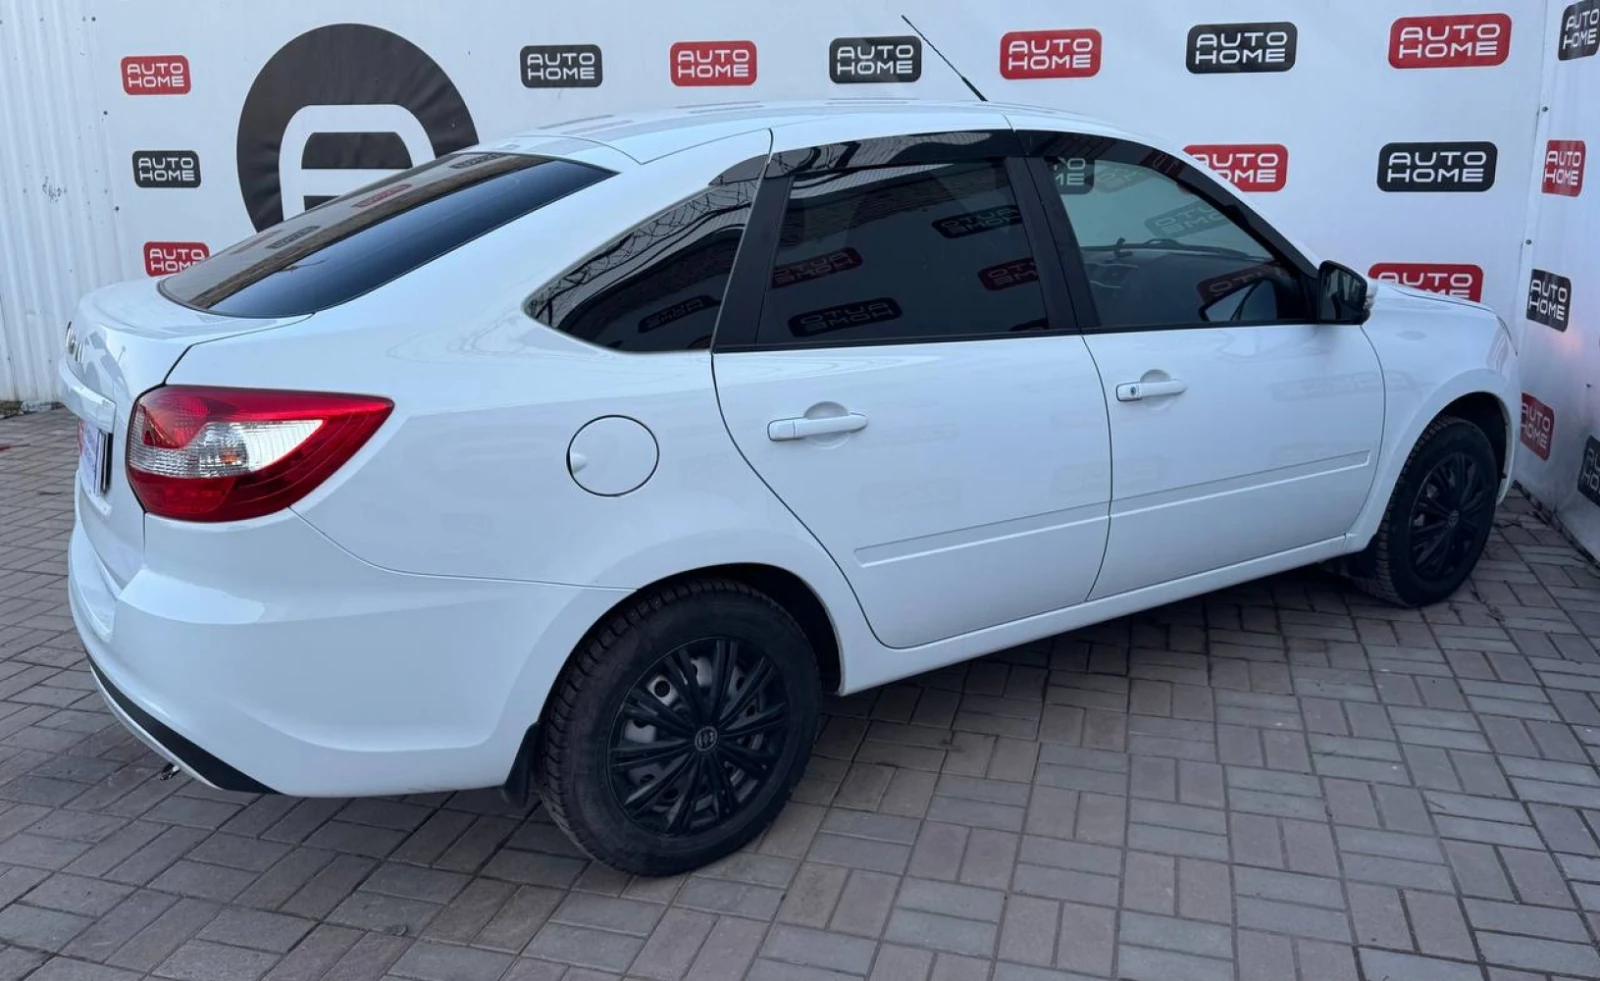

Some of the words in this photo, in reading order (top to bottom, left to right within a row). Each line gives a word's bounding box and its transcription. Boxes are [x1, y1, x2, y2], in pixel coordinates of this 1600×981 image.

[1565, 8, 1600, 31] AUTO
[1196, 31, 1288, 48] AUTO
[1400, 23, 1501, 42] AUTO
[1562, 27, 1598, 50] HOME
[837, 45, 914, 60] AUTO
[1008, 38, 1093, 55] AUTO
[1398, 41, 1498, 59] HOME
[527, 52, 595, 66] AUTO
[677, 49, 750, 63] AUTO
[1008, 54, 1092, 70] HOME
[1195, 48, 1286, 64] HOME
[127, 62, 184, 75] AUTO
[527, 67, 595, 80] HOME
[678, 64, 749, 78] HOME
[836, 60, 913, 75] HOME
[128, 75, 184, 88] HOME
[138, 157, 194, 169] AUTO
[1388, 151, 1487, 166] AUTO
[1545, 150, 1582, 167] AUTO
[139, 169, 195, 181] HOME
[1387, 168, 1484, 183] HOME
[1543, 168, 1579, 186] HOME
[149, 248, 206, 260] AUTO
[150, 260, 197, 272] HOM
[1530, 279, 1568, 303] AUTO
[1528, 296, 1566, 321] HOME
